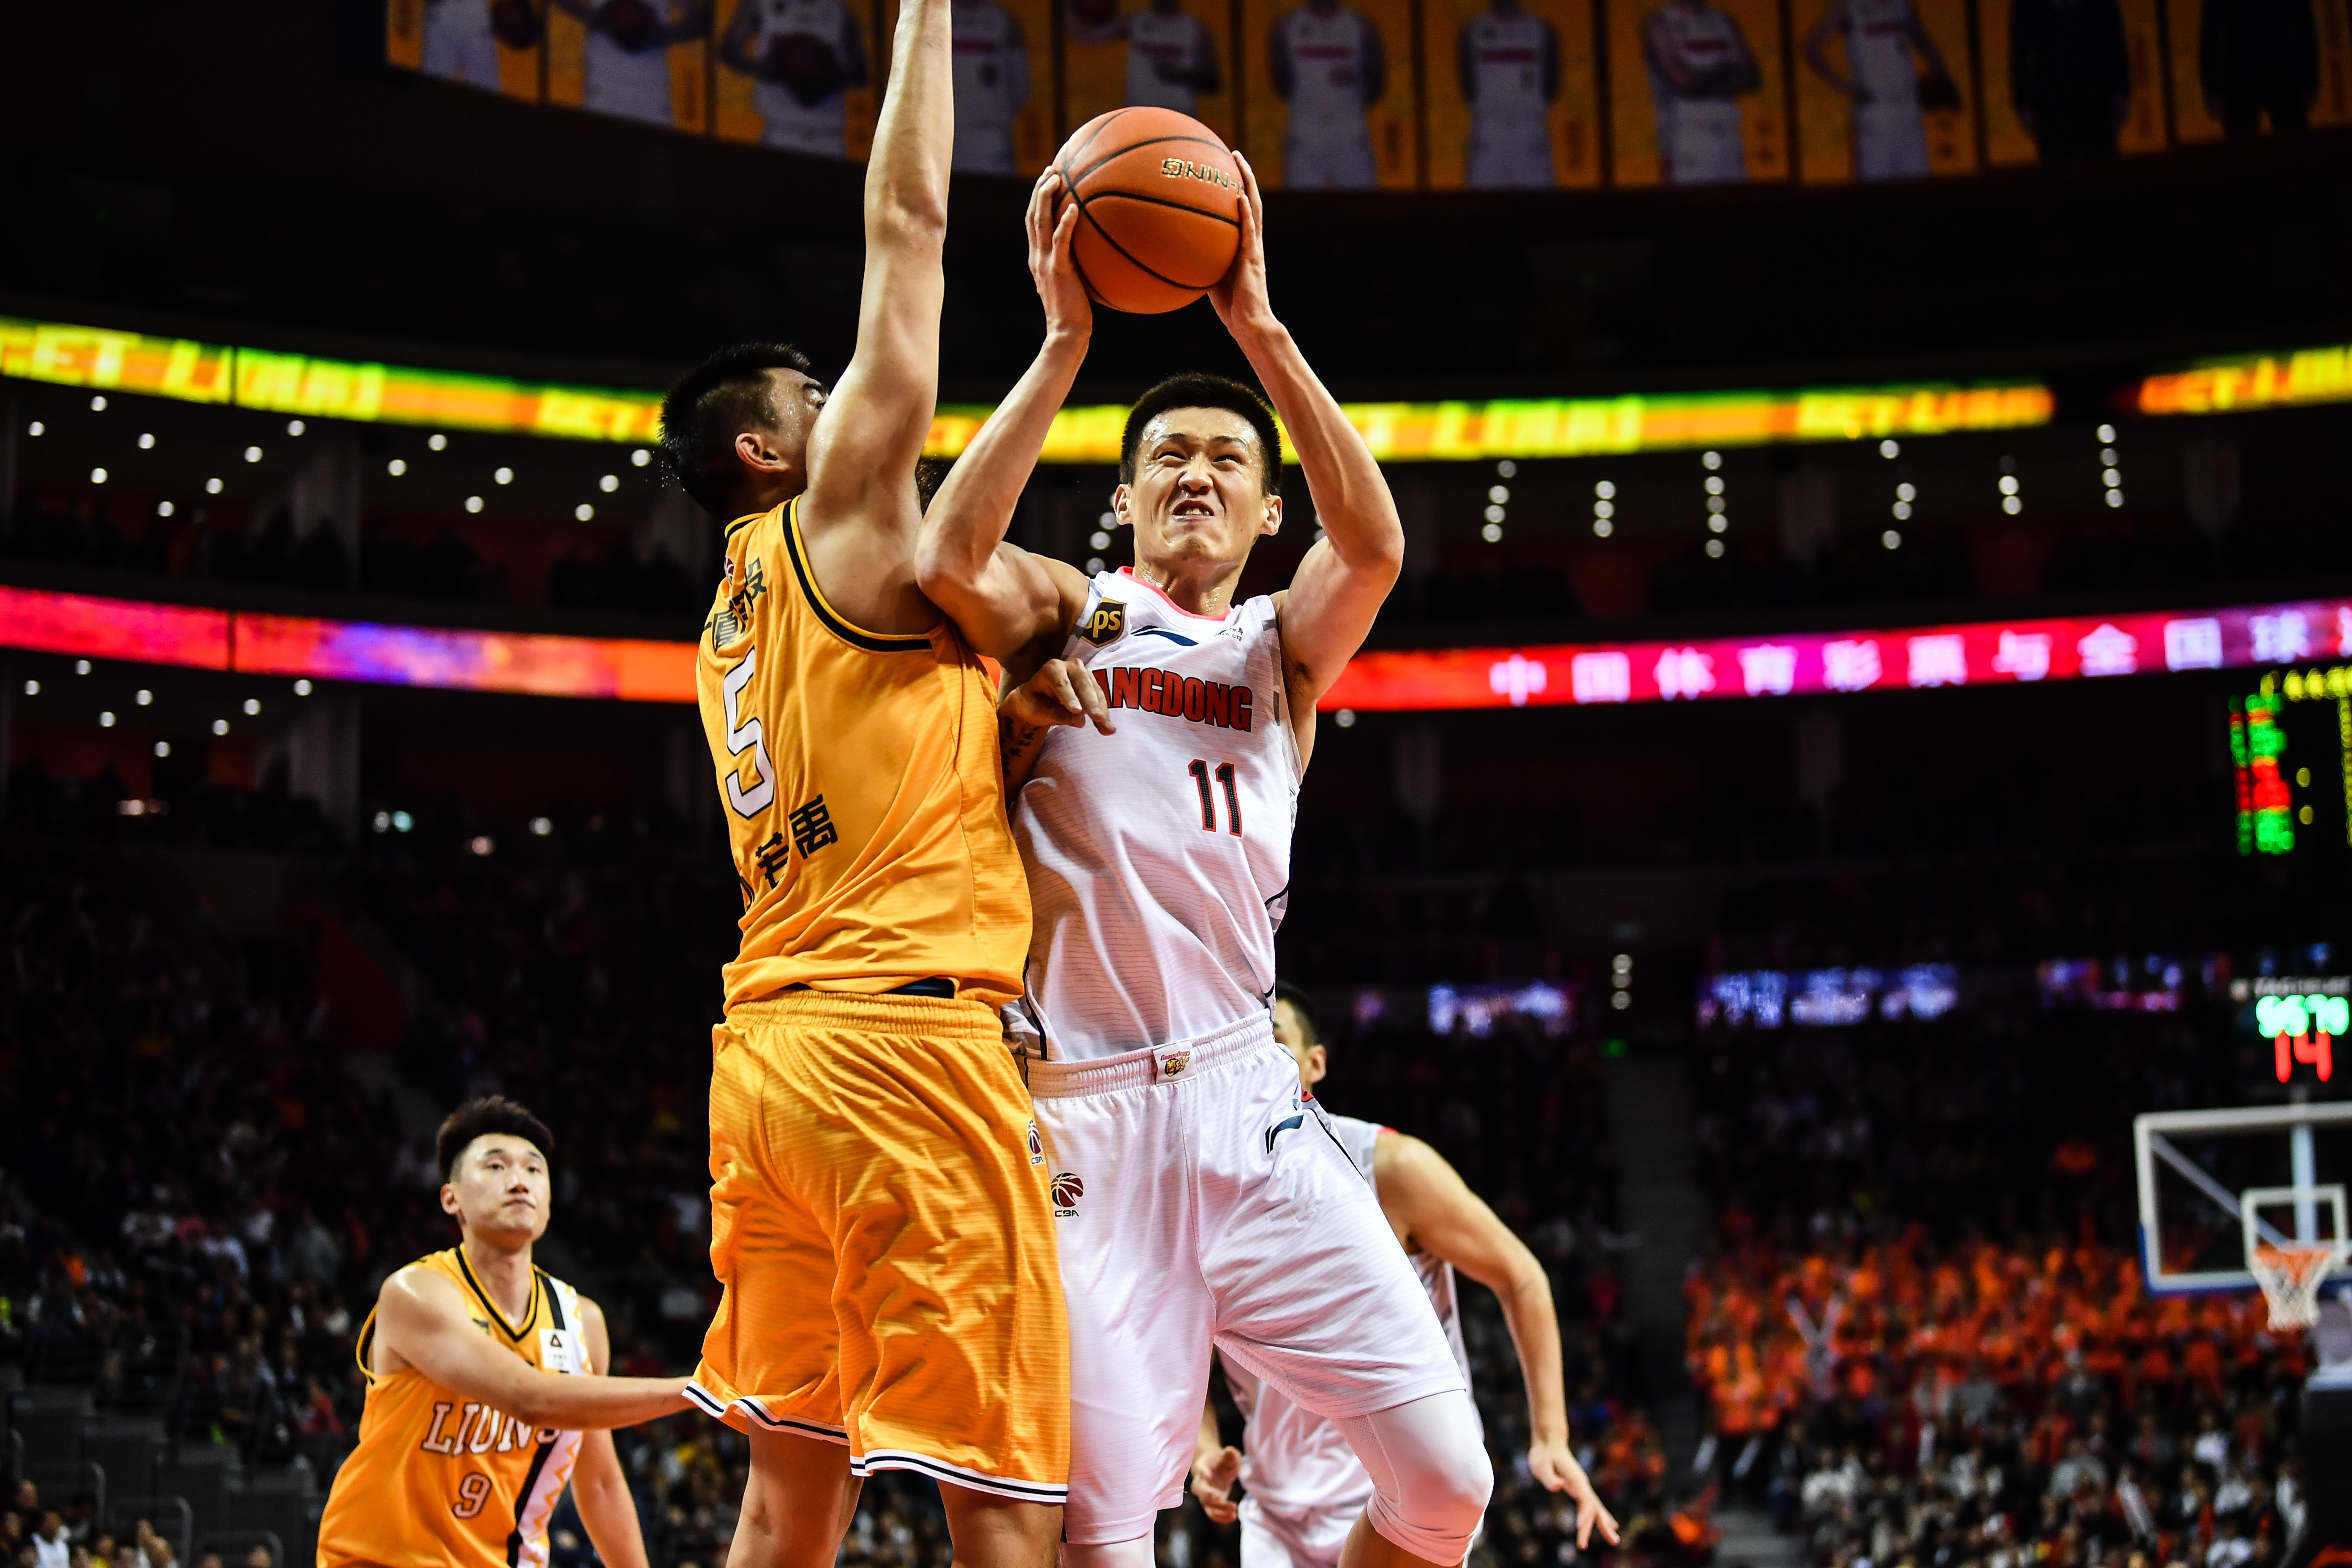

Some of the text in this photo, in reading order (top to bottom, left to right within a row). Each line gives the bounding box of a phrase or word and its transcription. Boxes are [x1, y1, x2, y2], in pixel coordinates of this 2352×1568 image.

[724, 645, 775, 819] 5
[1092, 667, 1252, 732] ANGDONG
[1187, 759, 1242, 838] 11
[2275, 1030, 2332, 1083] 14
[452, 1472, 493, 1519] 9
